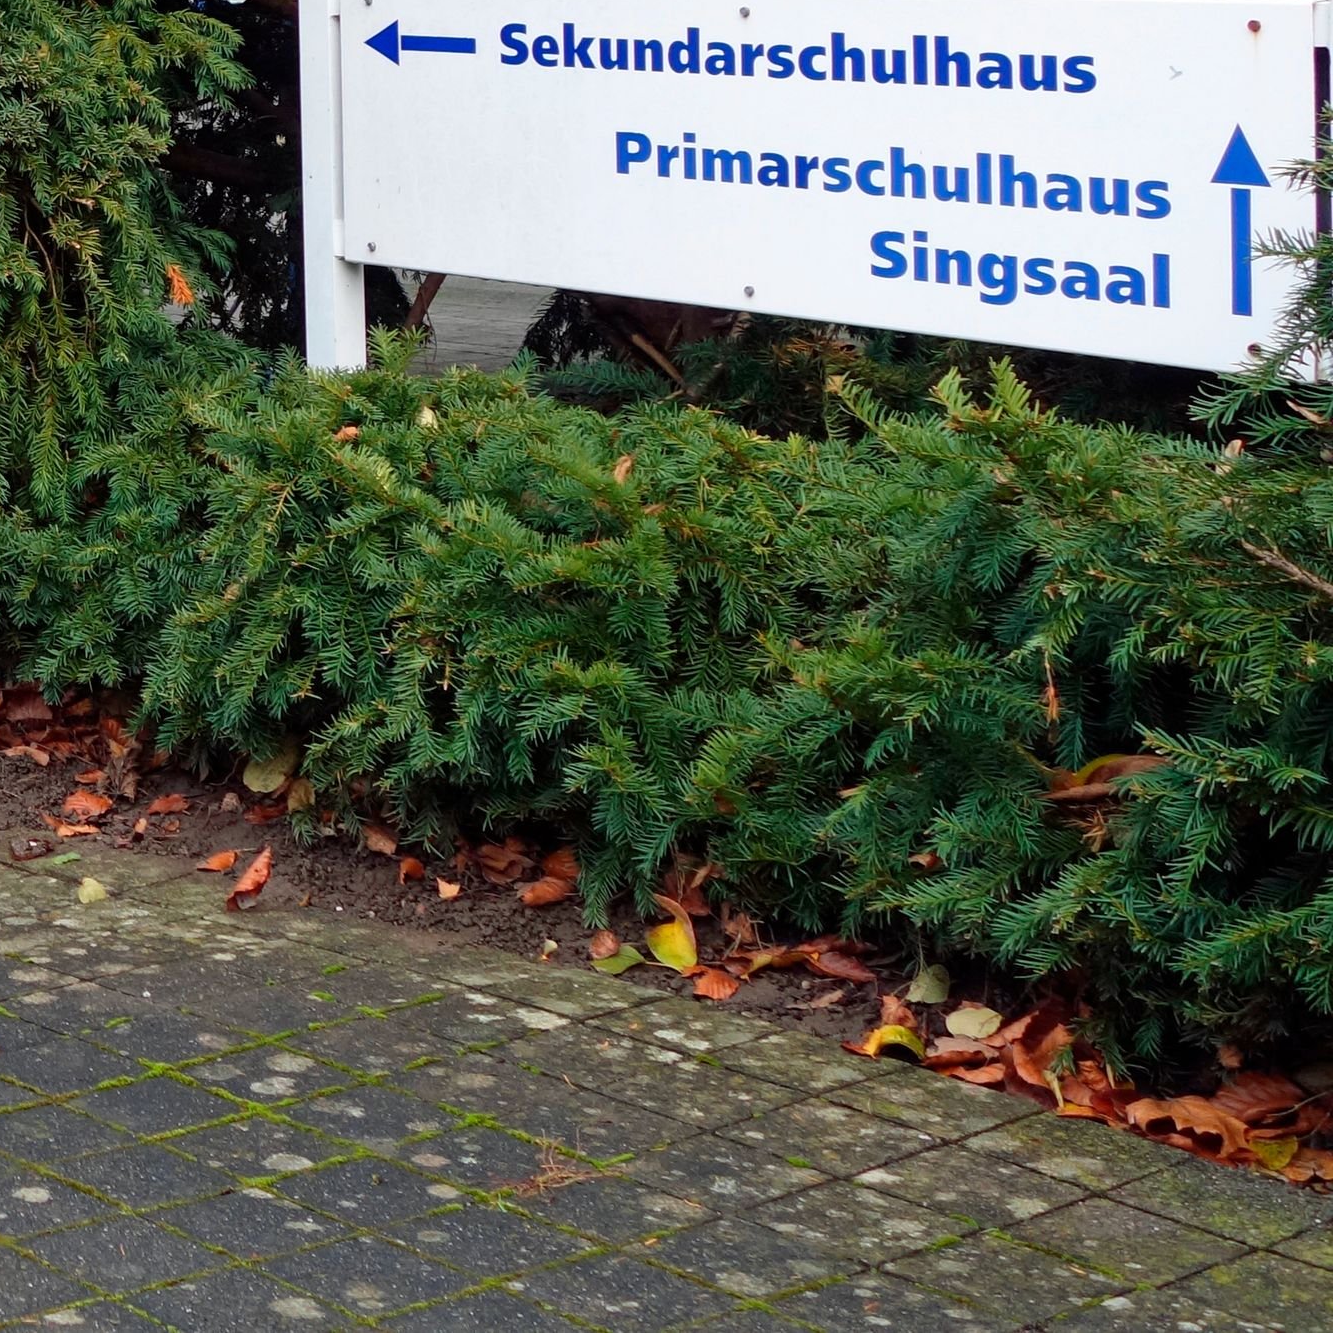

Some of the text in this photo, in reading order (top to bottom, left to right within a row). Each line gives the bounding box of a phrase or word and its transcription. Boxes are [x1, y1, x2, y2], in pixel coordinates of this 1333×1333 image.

[500, 22, 1097, 94] Sekundarschulhaus
[615, 131, 1172, 219] Primarschulhaus
[871, 230, 1172, 309] Singsaal
